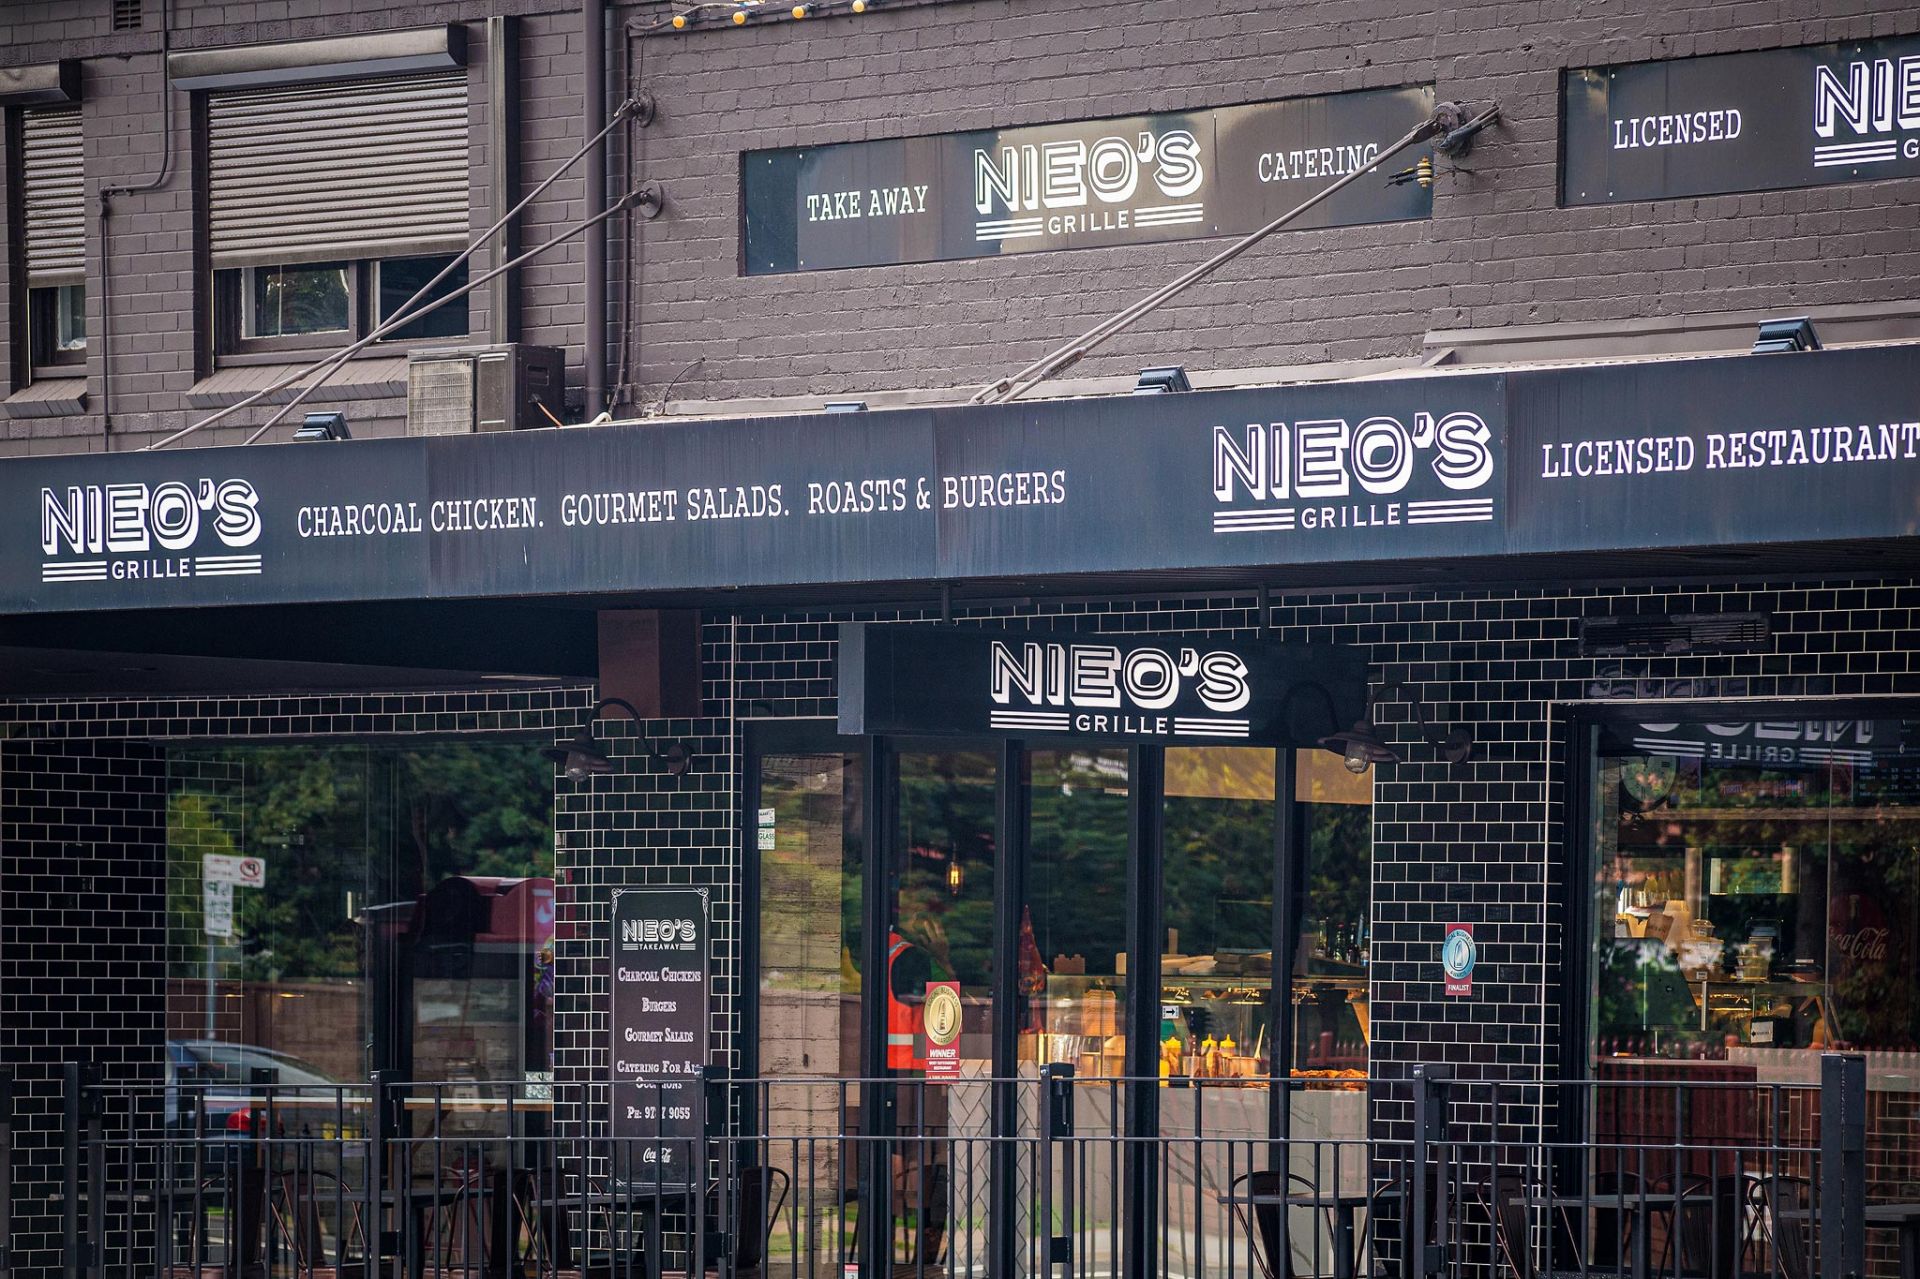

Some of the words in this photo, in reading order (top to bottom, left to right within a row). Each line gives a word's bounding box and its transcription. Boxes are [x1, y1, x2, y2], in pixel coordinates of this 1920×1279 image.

[1613, 109, 1742, 149] LICENSED
[974, 129, 1203, 214] NIEO'S
[1258, 143, 1378, 182] CATERING
[807, 188, 861, 222] TAKE
[868, 185, 928, 217] AWAY
[1048, 210, 1130, 235] GRILLE
[1213, 411, 1494, 502] NIEO'S
[1541, 436, 1695, 480] LICENSED
[1706, 422, 1920, 469] RESTAURANT
[41, 478, 262, 555] NIEO'S
[298, 503, 423, 538] CHARCOAL
[431, 497, 544, 532] CHICKEN.
[561, 490, 678, 527] GOURMET
[687, 484, 790, 521] SALADS.
[808, 479, 907, 515] ROASTS
[915, 477, 931, 510] &
[943, 470, 1066, 509] BURGERS
[1300, 503, 1401, 530] GRILLE
[112, 558, 190, 579] GRILLE
[991, 640, 1250, 712] NIEO'S
[1075, 714, 1168, 735] GRILLE
[622, 919, 696, 942] NIEO'S
[929, 1049, 957, 1058] WINNER
[644, 1106, 666, 1119] 977
[668, 1106, 691, 1120] 9055
